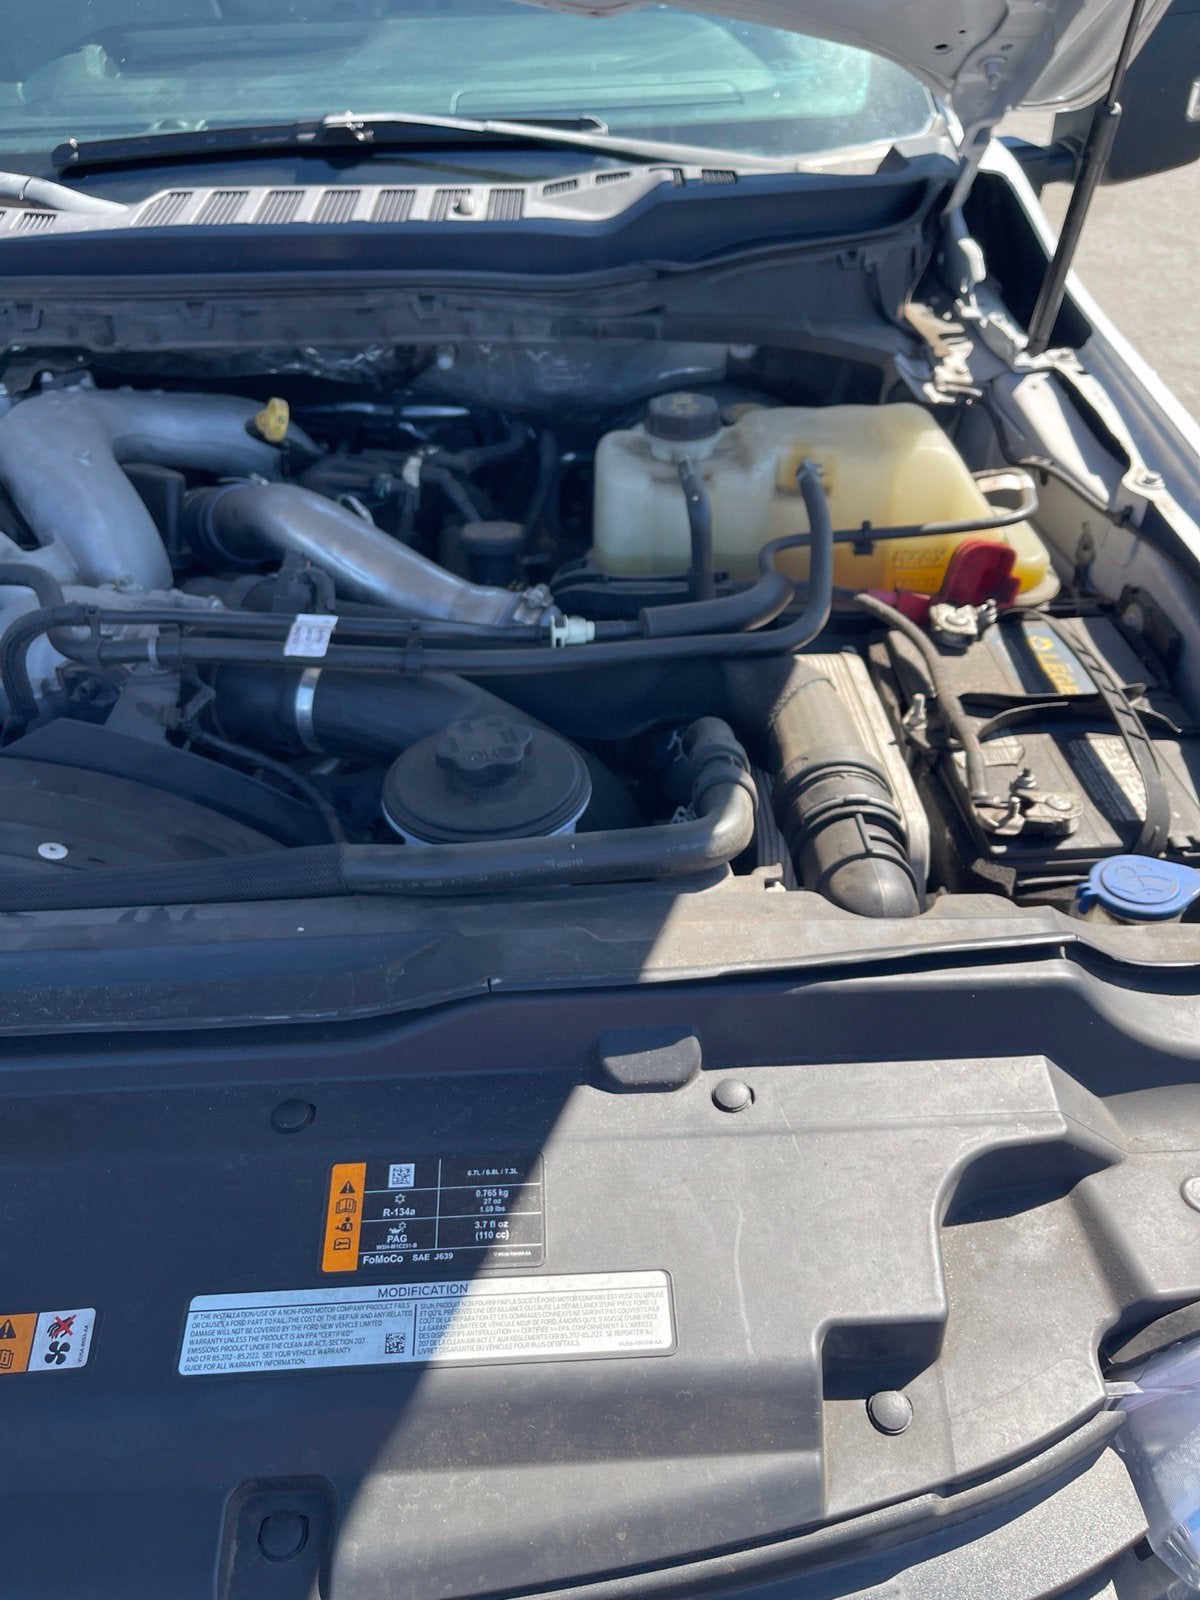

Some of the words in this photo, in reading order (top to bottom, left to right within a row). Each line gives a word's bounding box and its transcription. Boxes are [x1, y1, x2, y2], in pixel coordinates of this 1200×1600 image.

[476, 1189, 497, 1197] 0.765
[499, 1188, 508, 1198] kg
[383, 1208, 415, 1217] R-134a
[475, 1231, 493, 1241] (110
[496, 1230, 509, 1240] cc)
[363, 1255, 403, 1264] FoMoCo
[412, 1253, 430, 1261] SAE
[434, 1252, 453, 1261] J639
[378, 1284, 468, 1298] MODIFICATION
[188, 1345, 220, 1353] EMISSIONS
[229, 1360, 262, 1369] WARRANTY
